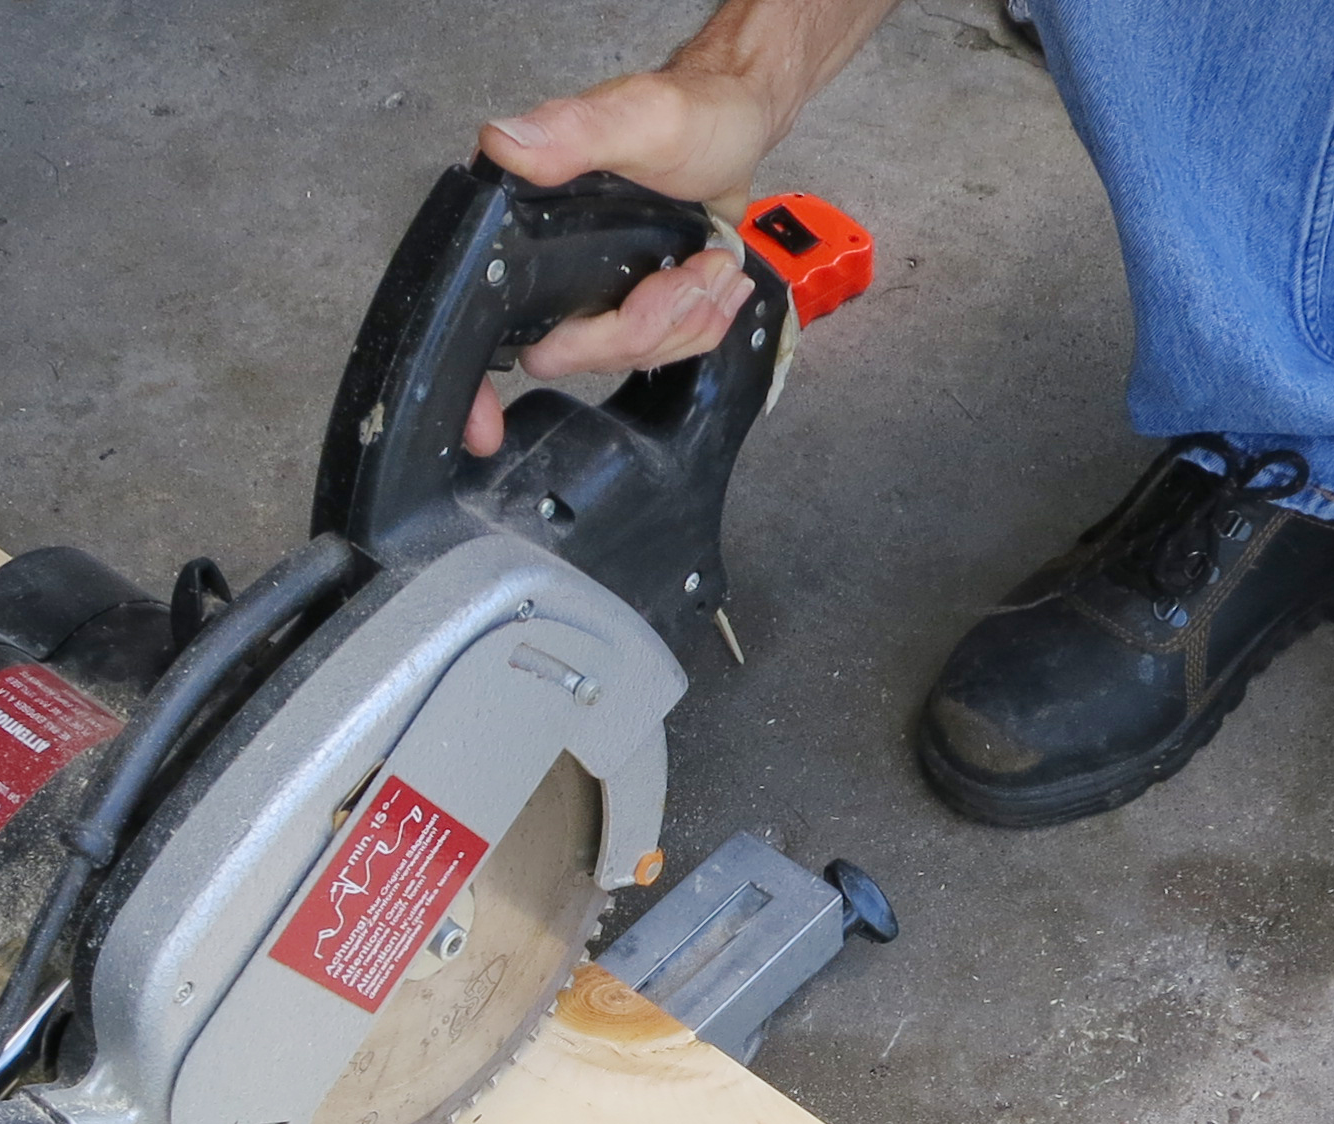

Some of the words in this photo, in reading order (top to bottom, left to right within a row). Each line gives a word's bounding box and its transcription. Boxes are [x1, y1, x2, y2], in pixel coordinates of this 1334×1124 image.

[345, 829, 375, 866] min.
[322, 913, 371, 976] Achtung!
[338, 920, 386, 984] Attention!
[383, 896, 404, 921] Only
[353, 929, 401, 993] Attention!
